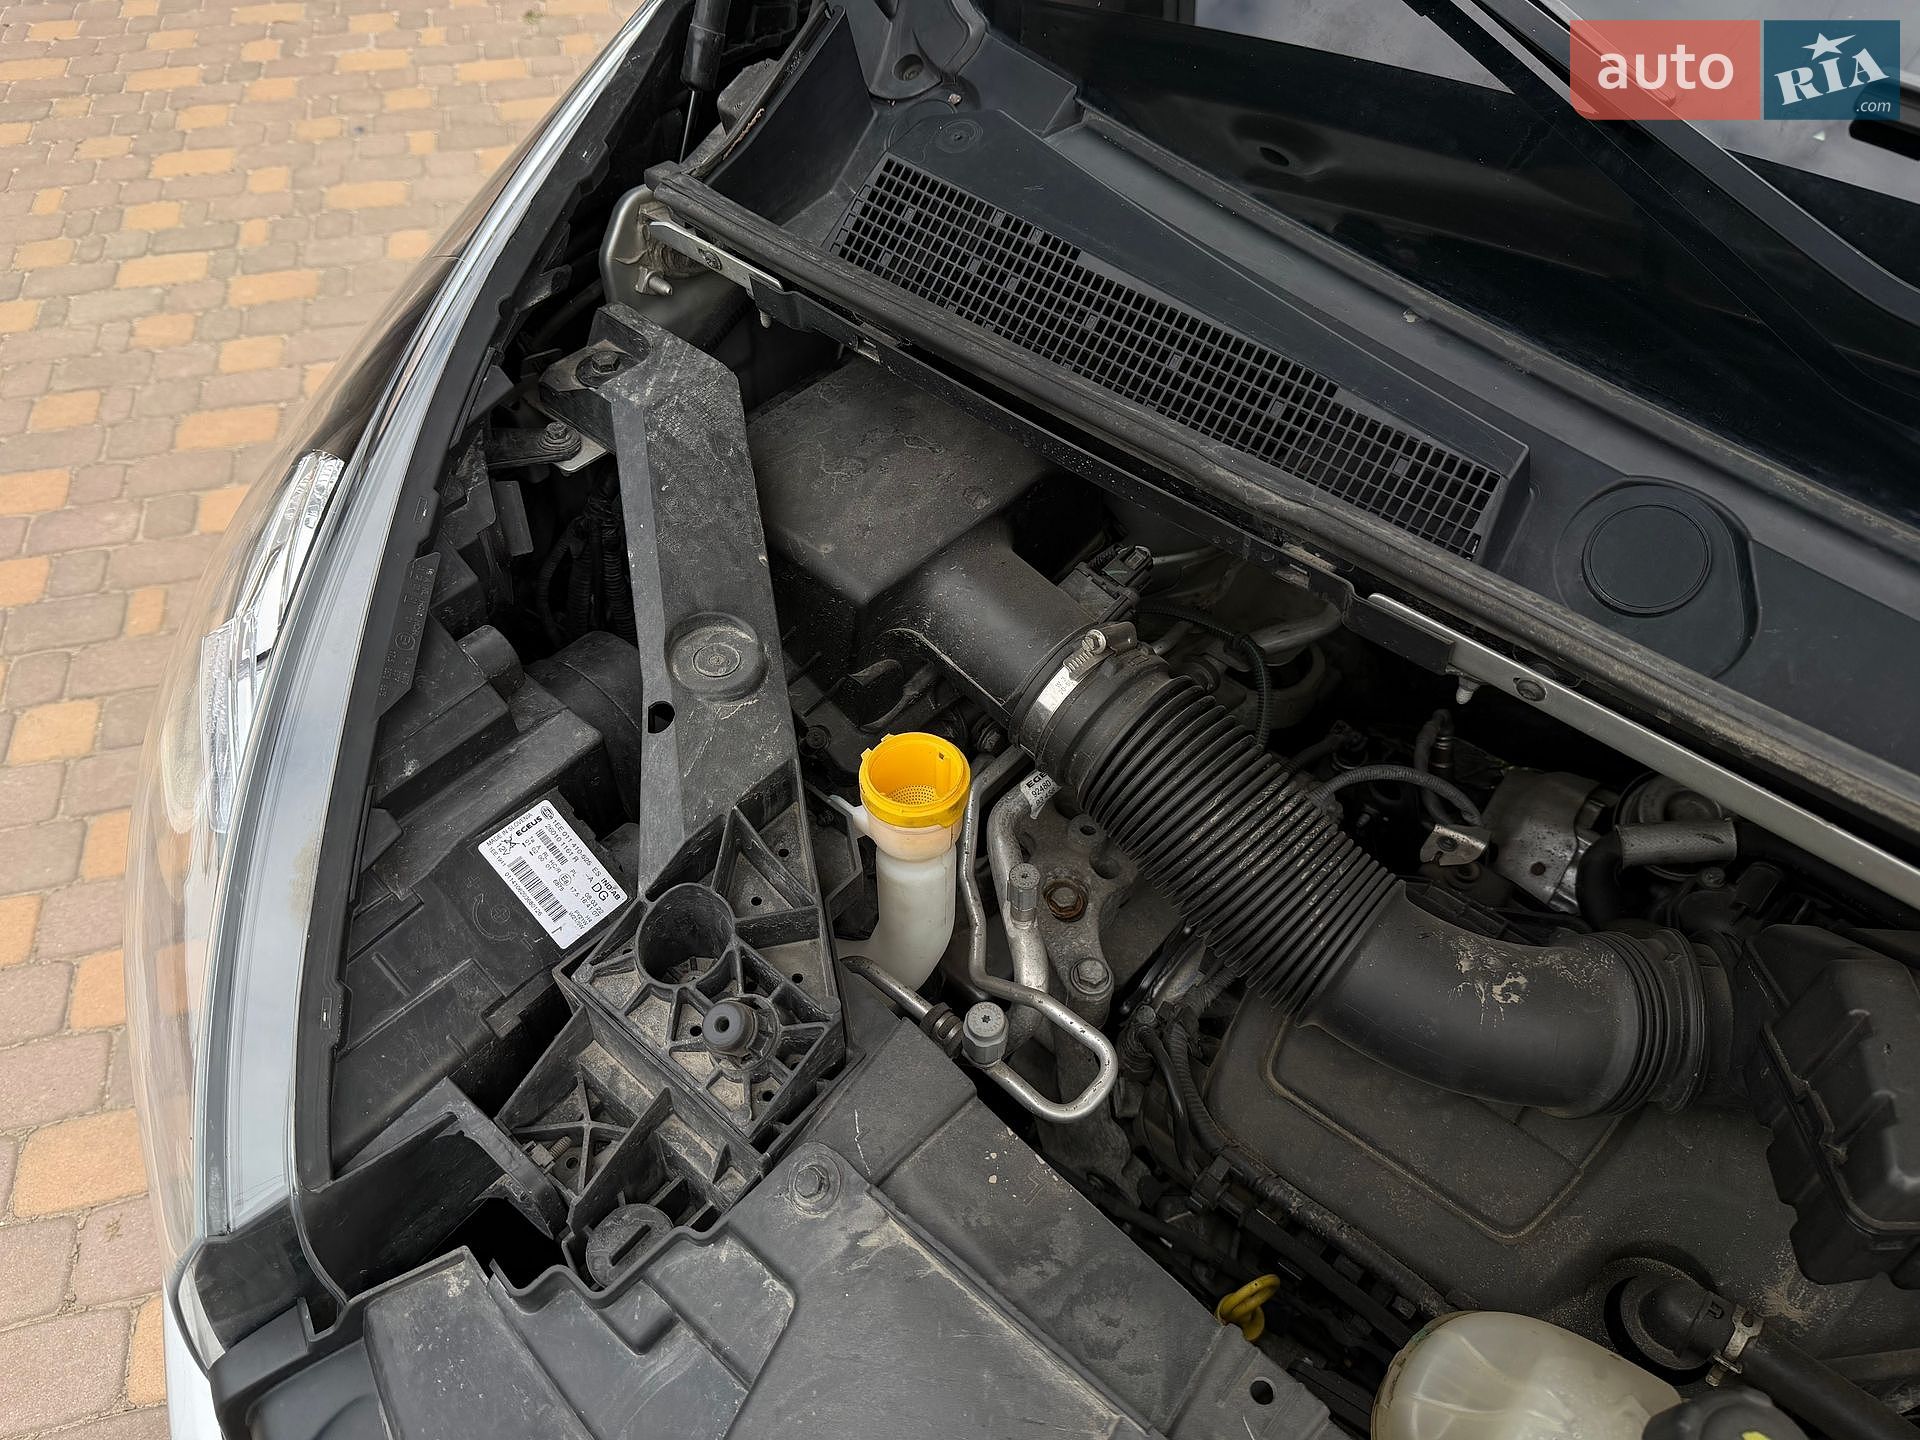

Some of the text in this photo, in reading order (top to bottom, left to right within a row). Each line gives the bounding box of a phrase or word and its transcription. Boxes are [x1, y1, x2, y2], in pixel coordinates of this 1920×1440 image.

[507, 812, 532, 831] SLOVENIA
[495, 842, 510, 857] 12V
[551, 819, 564, 832] 1EE
[561, 830, 573, 842] 011
[591, 866, 601, 876] ES
[590, 881, 610, 902] DG
